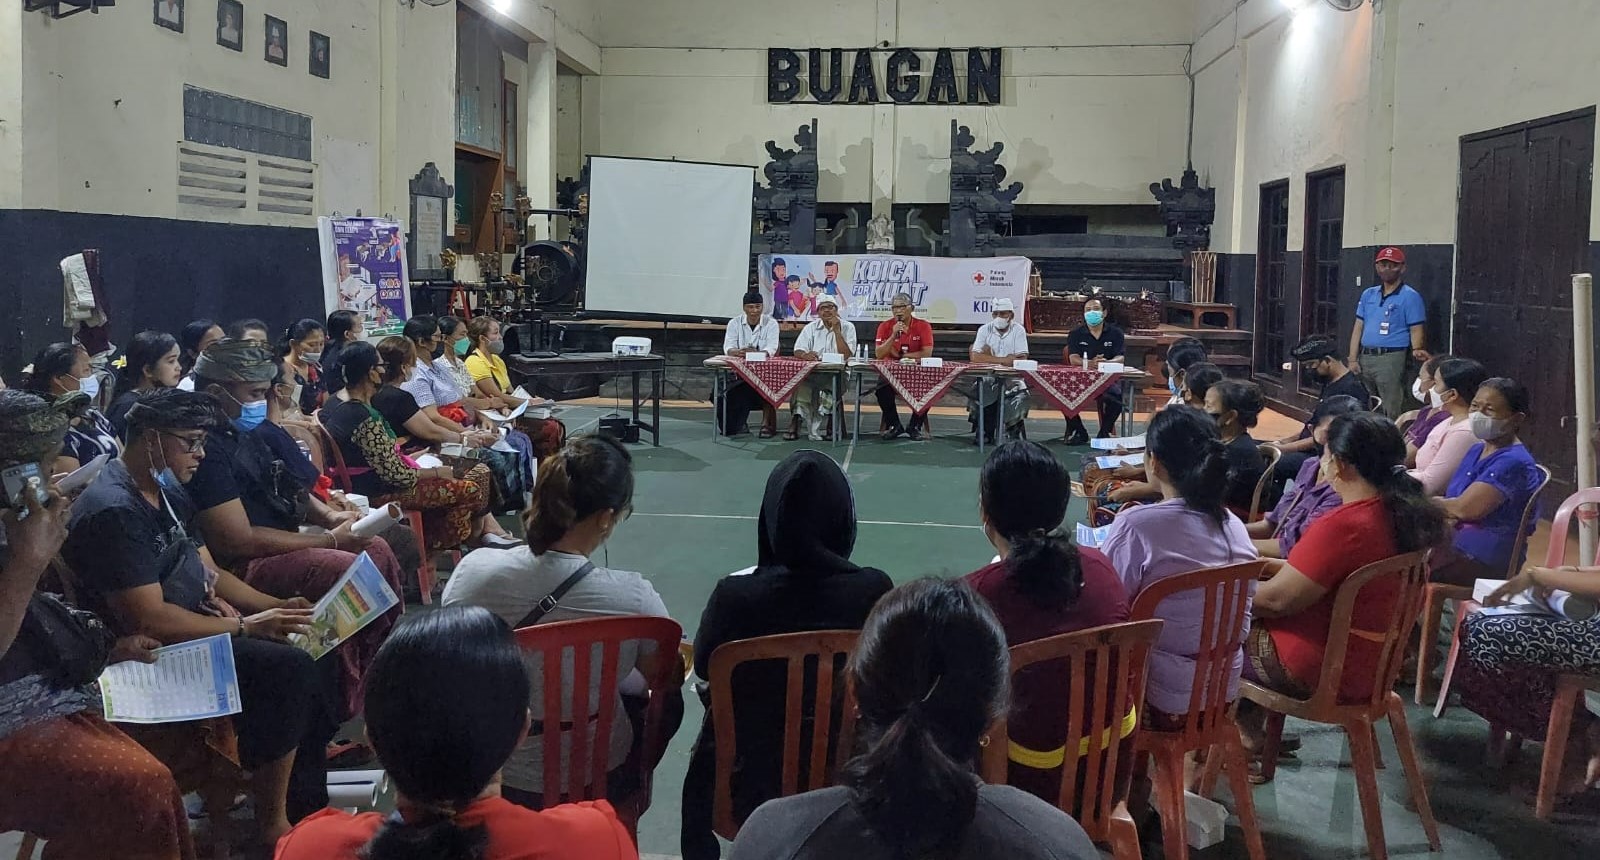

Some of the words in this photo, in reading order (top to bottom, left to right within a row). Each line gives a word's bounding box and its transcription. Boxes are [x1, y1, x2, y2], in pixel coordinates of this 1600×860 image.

[768, 48, 1001, 104] BUAGAN
[853, 260, 919, 283] KOICA
[852, 284, 870, 296] FOR
